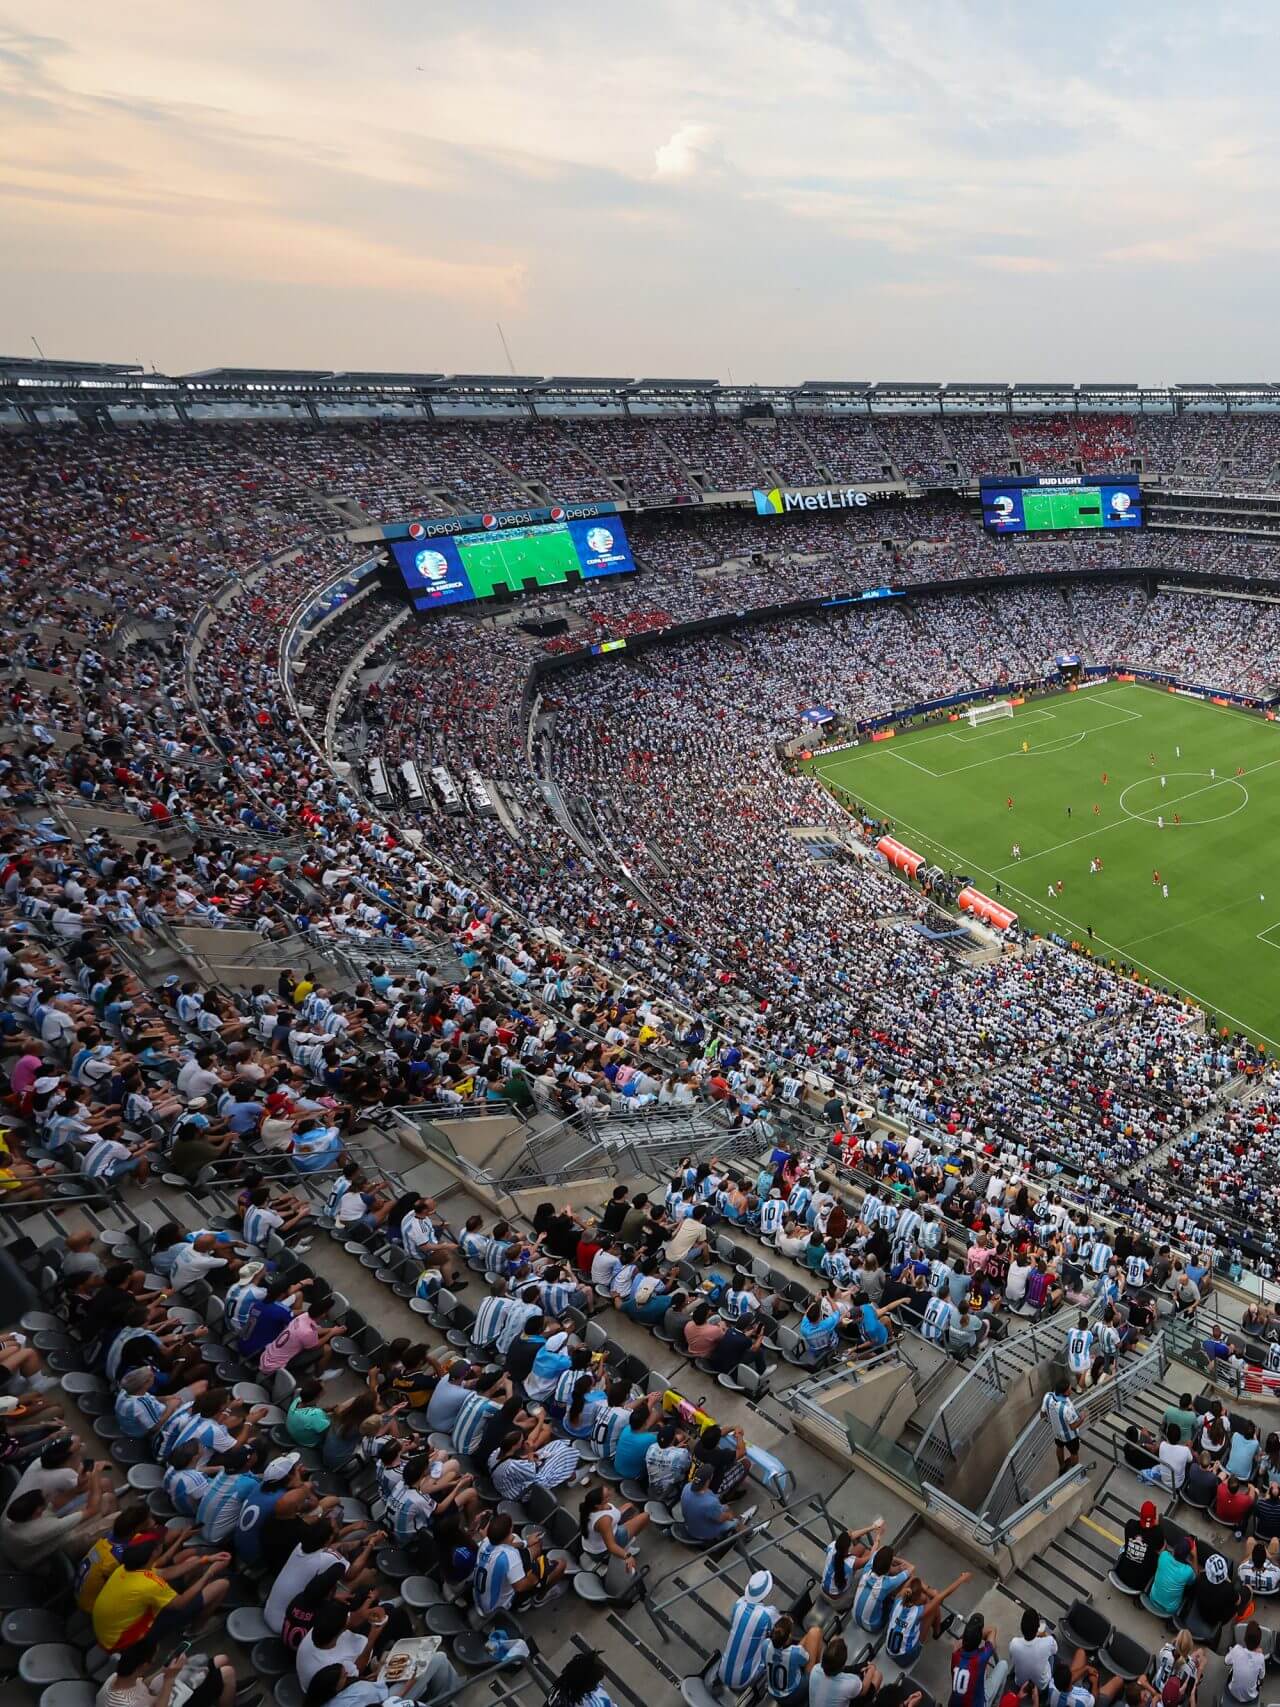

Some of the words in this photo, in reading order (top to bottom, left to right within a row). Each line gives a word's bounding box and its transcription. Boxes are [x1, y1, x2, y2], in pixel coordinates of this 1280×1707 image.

[1039, 477, 1057, 485] BUD
[1057, 477, 1082, 485] LIGHT
[784, 488, 868, 511] MetLife
[498, 512, 532, 527] pepsi
[566, 505, 599, 519] pepsi
[426, 521, 462, 537] pepsi
[813, 740, 860, 757] mastercard
[764, 1207, 776, 1221] 10
[1130, 1264, 1140, 1278] 10
[926, 1310, 937, 1323] 10
[1071, 1339, 1084, 1354] 10
[1212, 1560, 1224, 1573] 10
[768, 1663, 788, 1691] 10
[953, 1666, 970, 1695] 10
